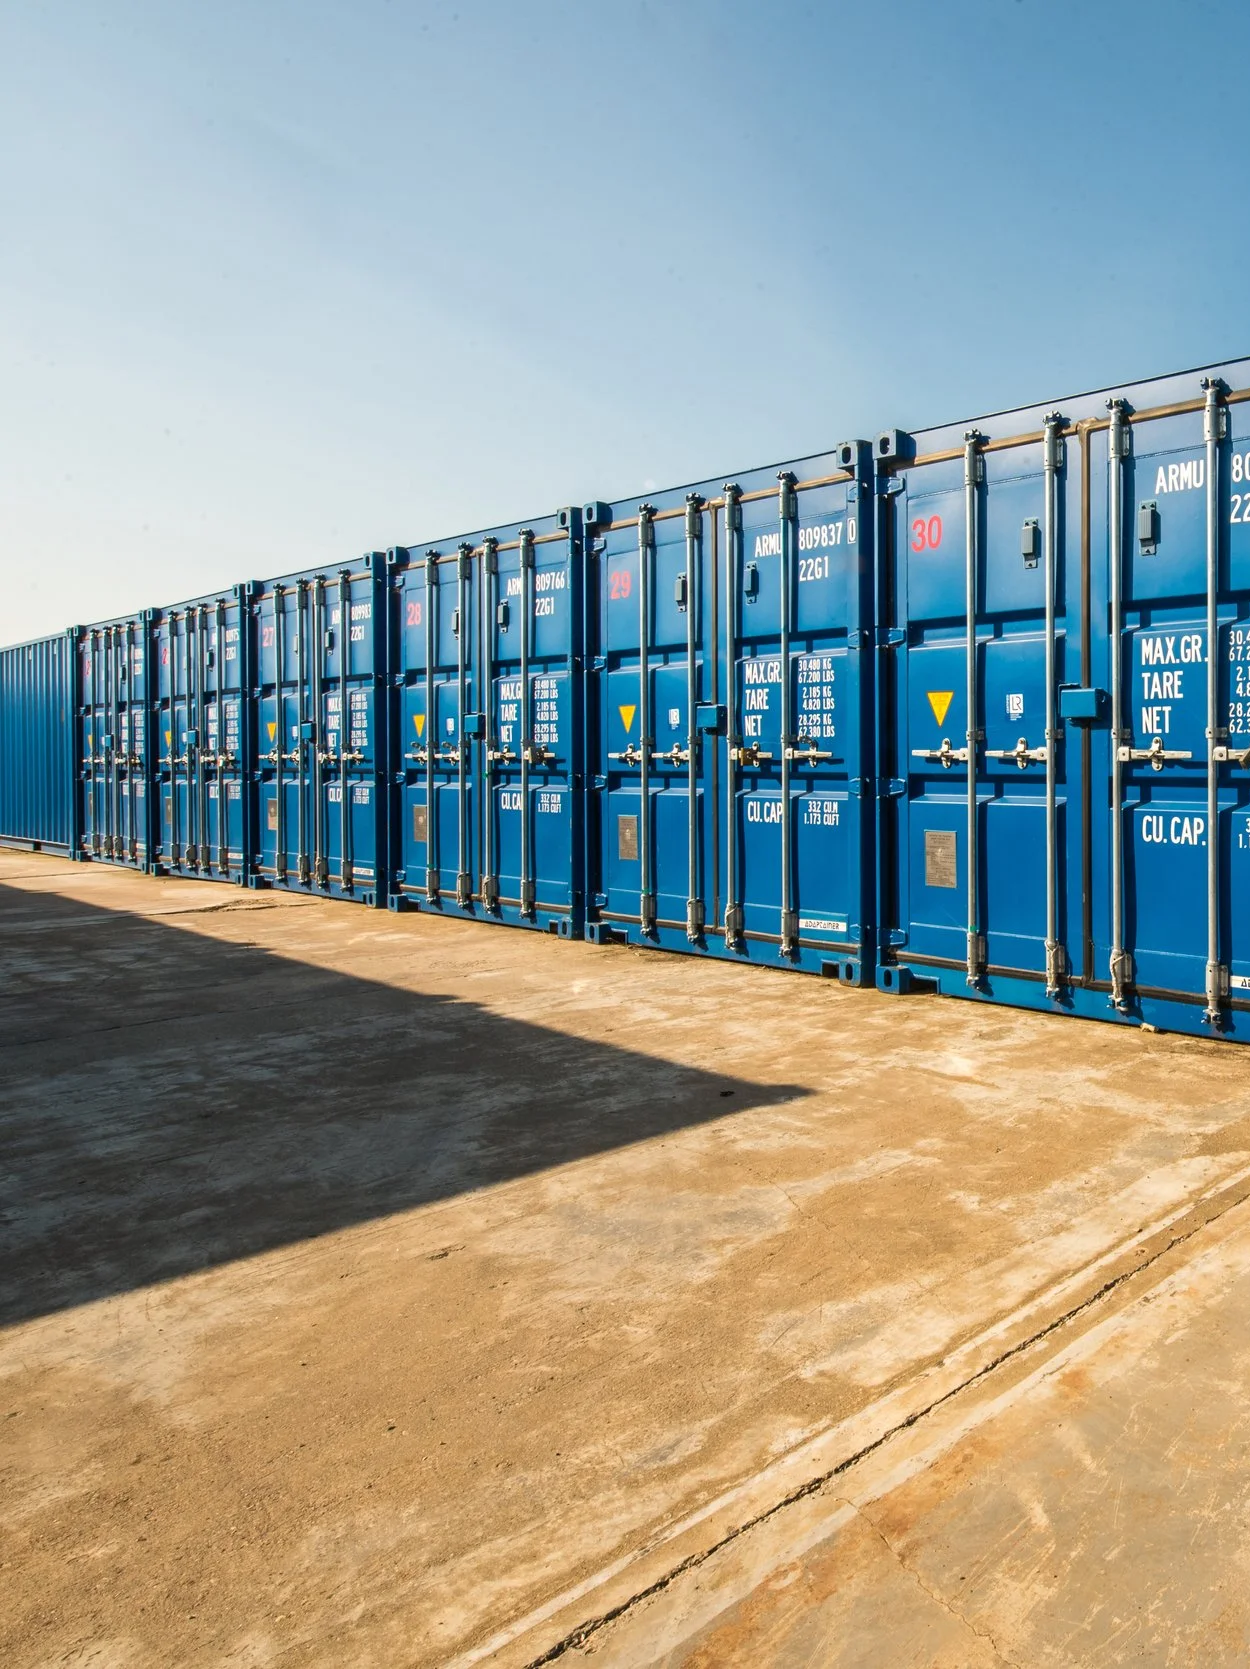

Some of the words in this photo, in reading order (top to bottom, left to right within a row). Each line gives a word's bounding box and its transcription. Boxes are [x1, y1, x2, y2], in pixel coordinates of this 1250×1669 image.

[1155, 459, 1205, 495] ARMU
[799, 522, 843, 550] 809837
[911, 514, 943, 553] 30
[799, 555, 829, 582] 22G1
[535, 570, 565, 592] 809766
[610, 571, 631, 600] 29
[407, 602, 421, 625] 28
[535, 596, 555, 617] 22G1
[822, 658, 832, 670] KG
[822, 670, 835, 682] LBS
[1141, 670, 1184, 700] TARE
[745, 688, 770, 711] TARE
[822, 685, 832, 698] KG
[822, 698, 835, 710] LBS
[501, 703, 518, 722] TARE
[1142, 705, 1172, 735] NET
[501, 725, 513, 742] NET
[744, 714, 763, 737] NET
[822, 713, 832, 725] KG
[823, 725, 836, 738] LBS
